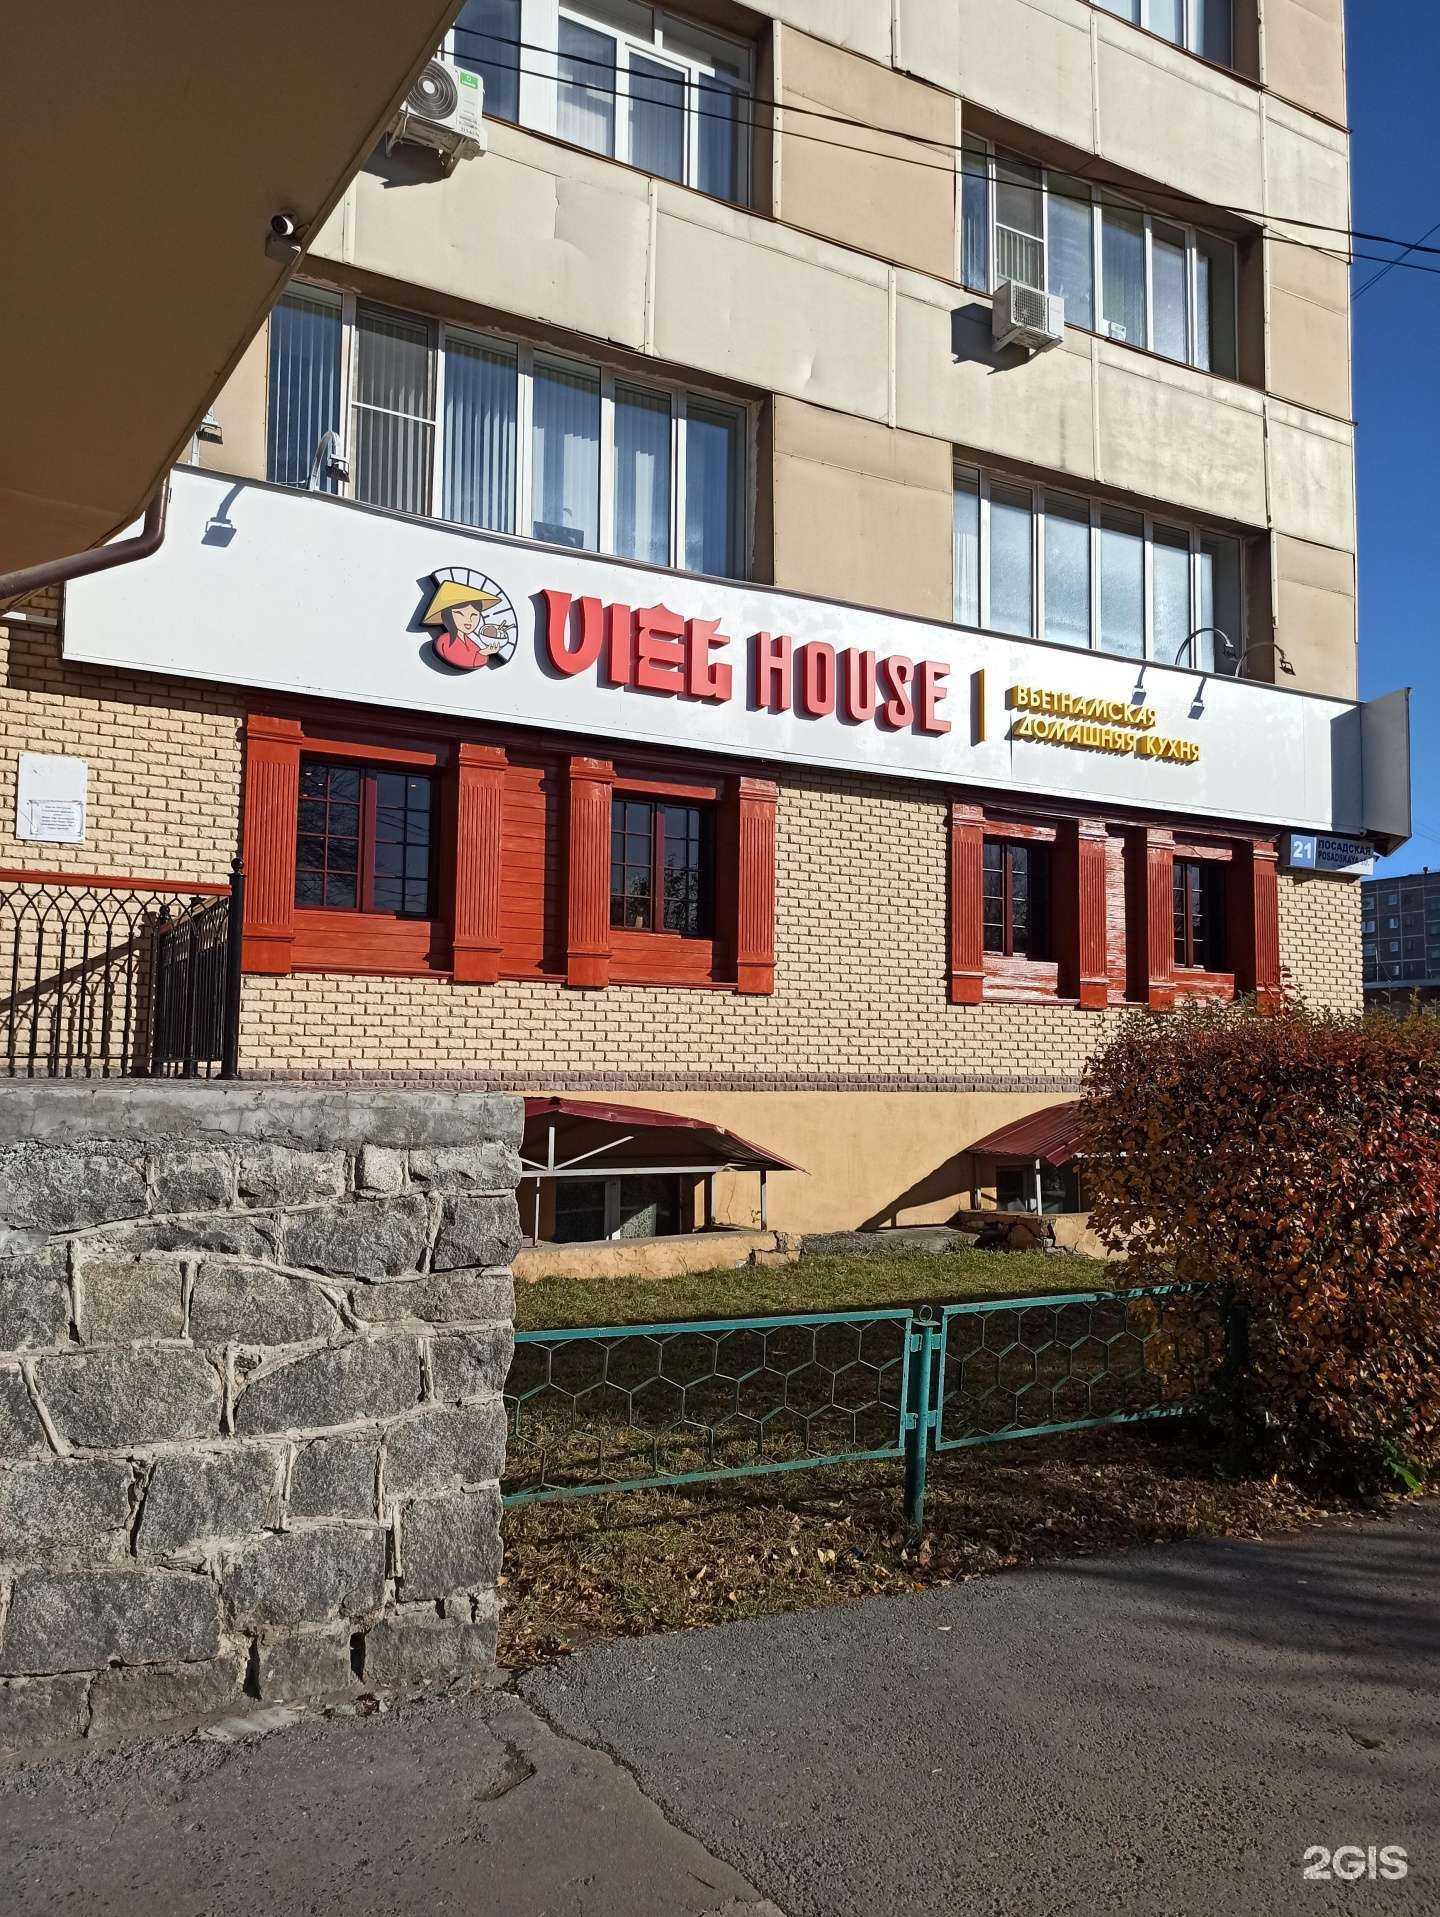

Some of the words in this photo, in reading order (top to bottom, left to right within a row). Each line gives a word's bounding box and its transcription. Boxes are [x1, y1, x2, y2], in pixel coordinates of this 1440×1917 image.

[754, 631, 952, 735] HOUSE
[1015, 685, 1160, 728] ВЬЕТНАМСКАЯ
[1018, 714, 1138, 753] ДОМАШНЯЯ
[1145, 734, 1201, 763] КУХНЯ
[1293, 840, 1312, 860] 21
[1318, 839, 1371, 856] ПОСАДСКАЯ
